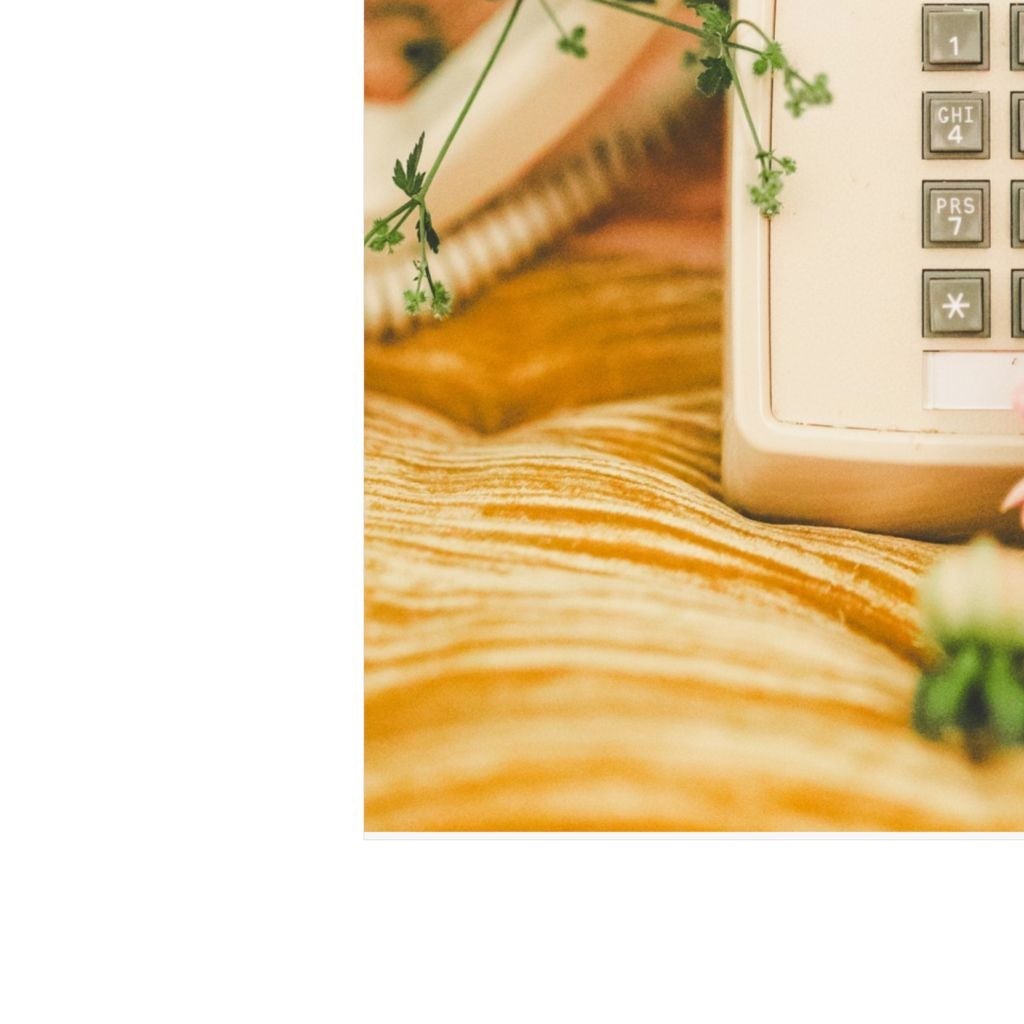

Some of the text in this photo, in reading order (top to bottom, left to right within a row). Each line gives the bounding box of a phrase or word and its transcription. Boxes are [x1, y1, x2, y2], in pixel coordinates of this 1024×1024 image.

[949, 36, 959, 56] 1
[938, 107, 974, 123] GHI
[947, 125, 963, 143] 4
[936, 198, 975, 214] PRS
[948, 217, 962, 236] 7
